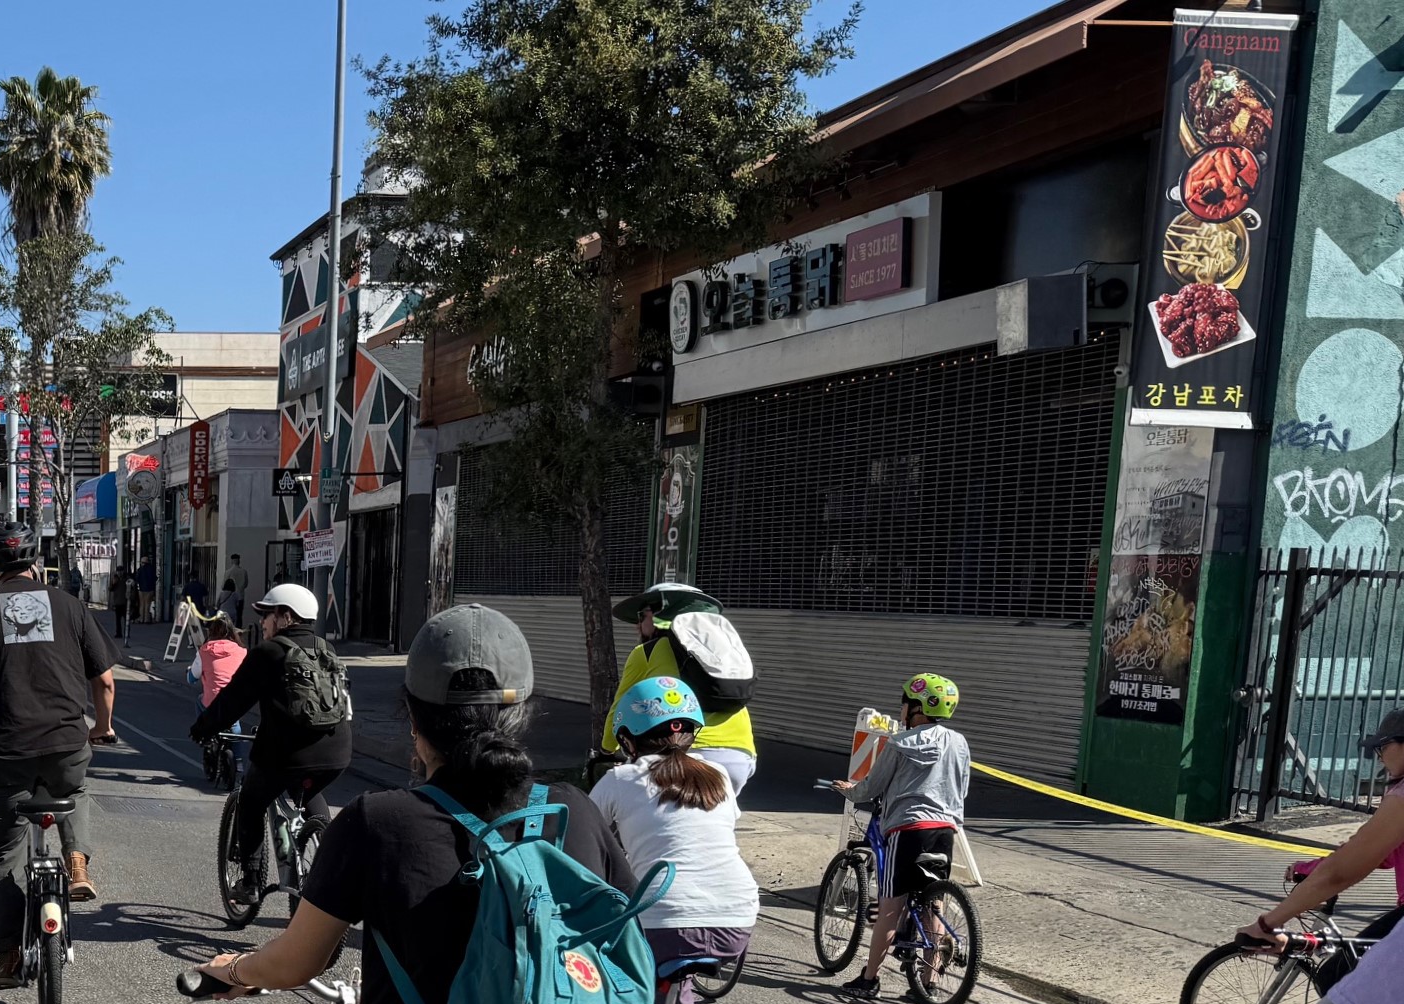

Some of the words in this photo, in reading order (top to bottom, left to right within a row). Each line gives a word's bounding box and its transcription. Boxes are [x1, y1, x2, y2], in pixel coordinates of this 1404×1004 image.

[876, 263, 897, 282] 1977
[1146, 383, 1245, 408] 강남포차
[192, 431, 207, 501] COCKTAILS
[308, 549, 332, 558] ANYTIME
[1109, 680, 1139, 697] 한마리
